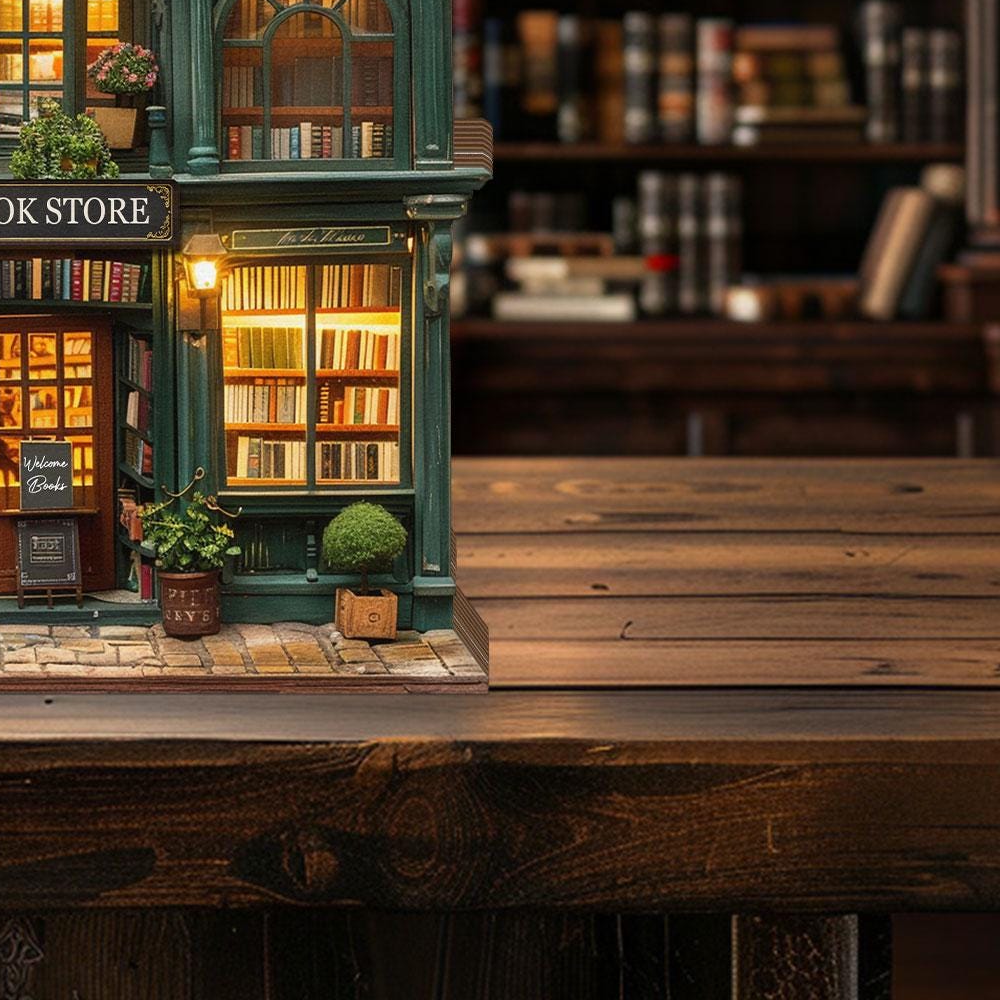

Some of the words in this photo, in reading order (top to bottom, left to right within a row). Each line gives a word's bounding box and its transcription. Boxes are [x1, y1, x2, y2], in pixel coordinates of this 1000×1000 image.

[45, 196, 150, 225] STORE
[23, 455, 69, 472] Welcome
[26, 474, 68, 494] Books
